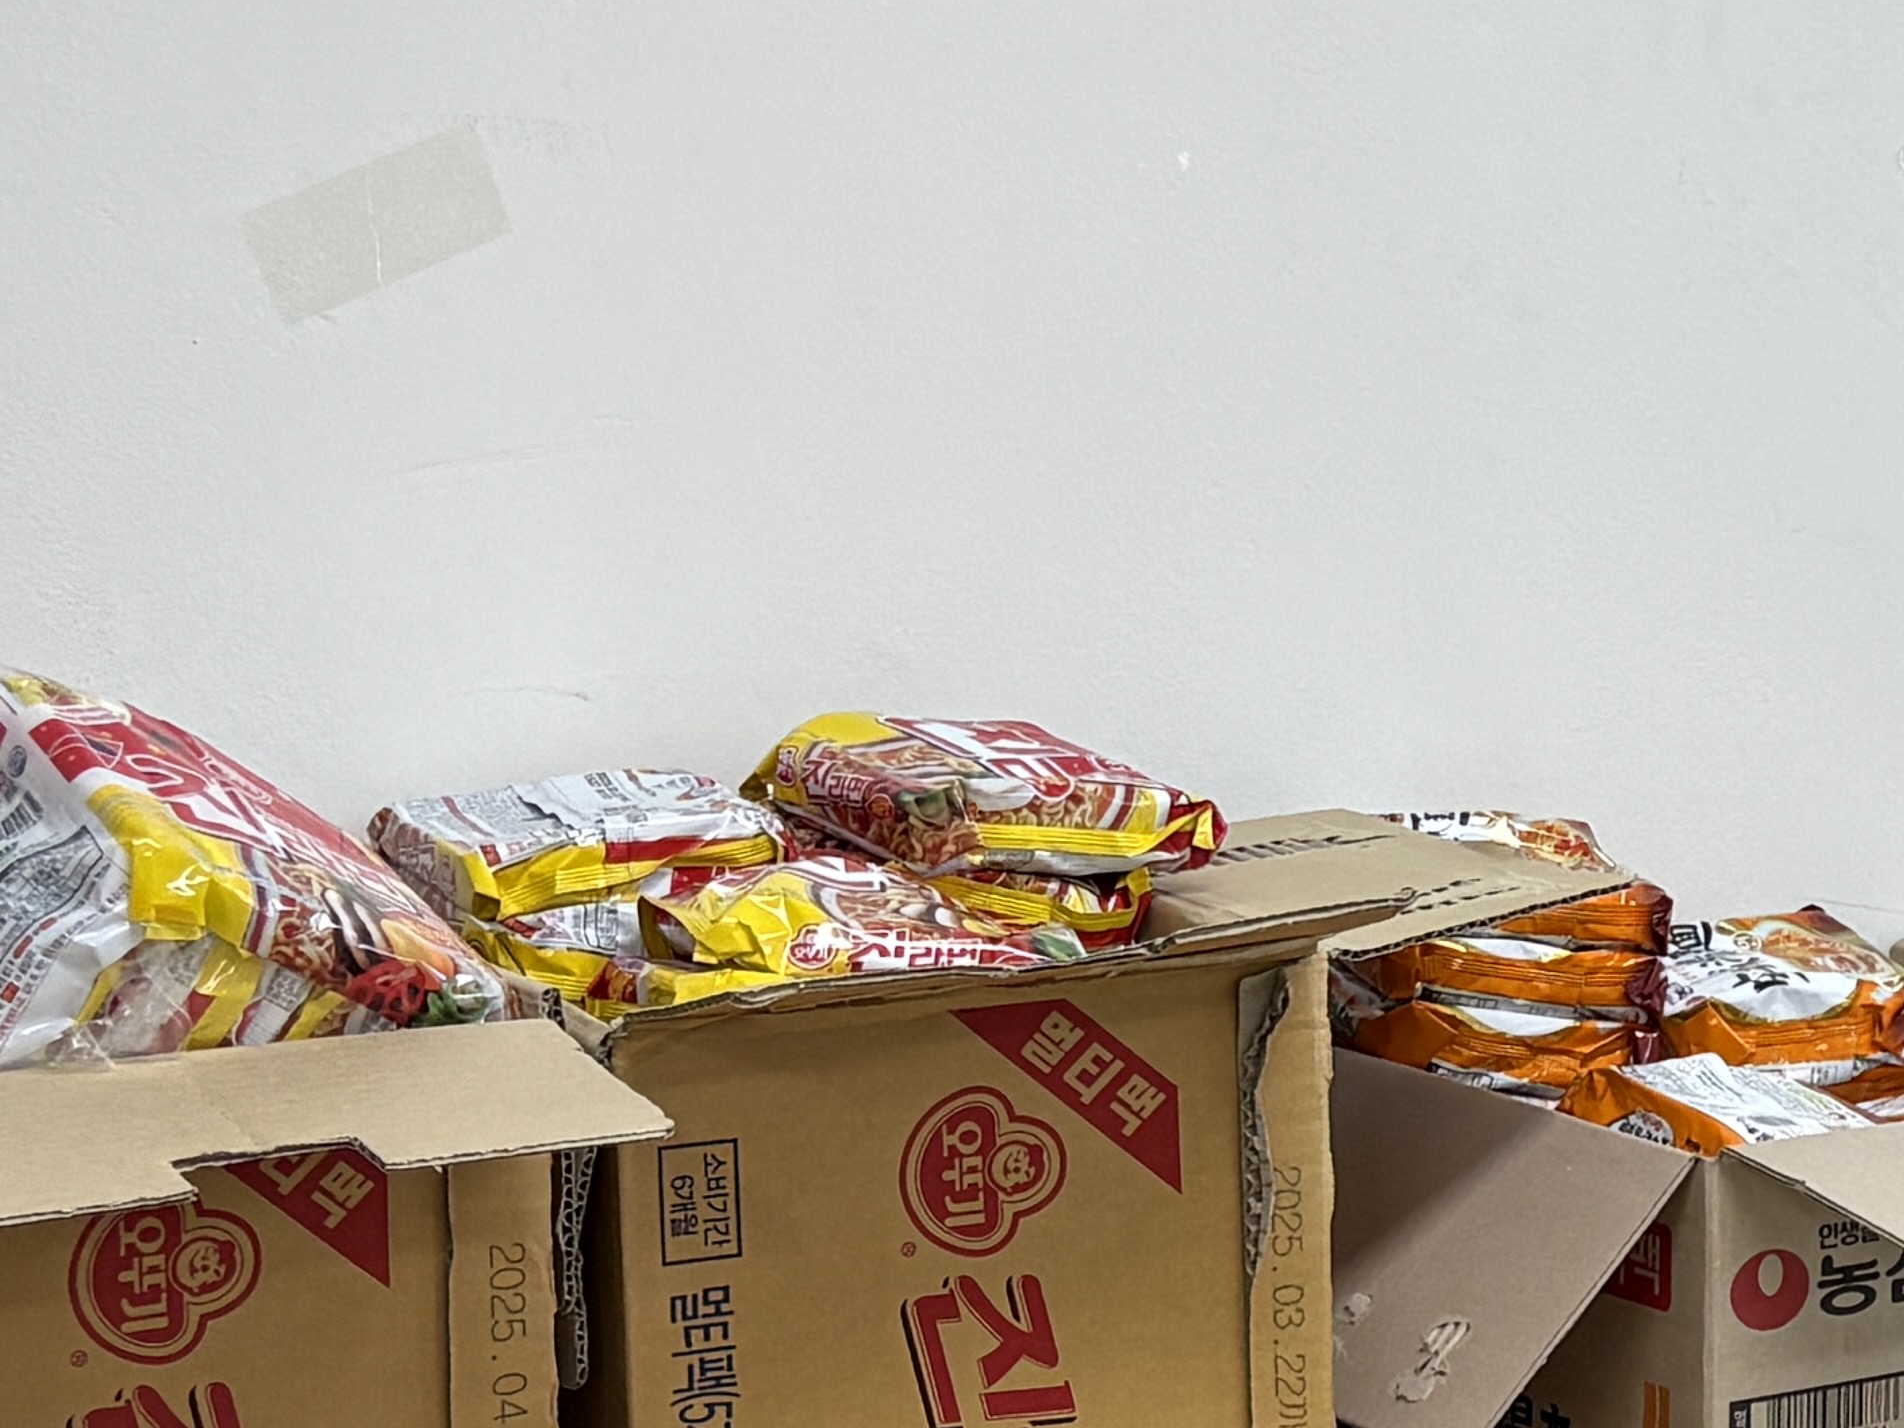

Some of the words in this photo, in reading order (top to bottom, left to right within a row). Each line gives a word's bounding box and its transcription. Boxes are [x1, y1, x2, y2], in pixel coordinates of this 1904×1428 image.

[1020, 1008, 1169, 1138] 멀티팩
[668, 1174, 697, 1238] 6개월
[699, 1149, 732, 1249] 소비기간
[939, 1110, 989, 1229] 오뚜기
[117, 1212, 169, 1336] 오뚜기
